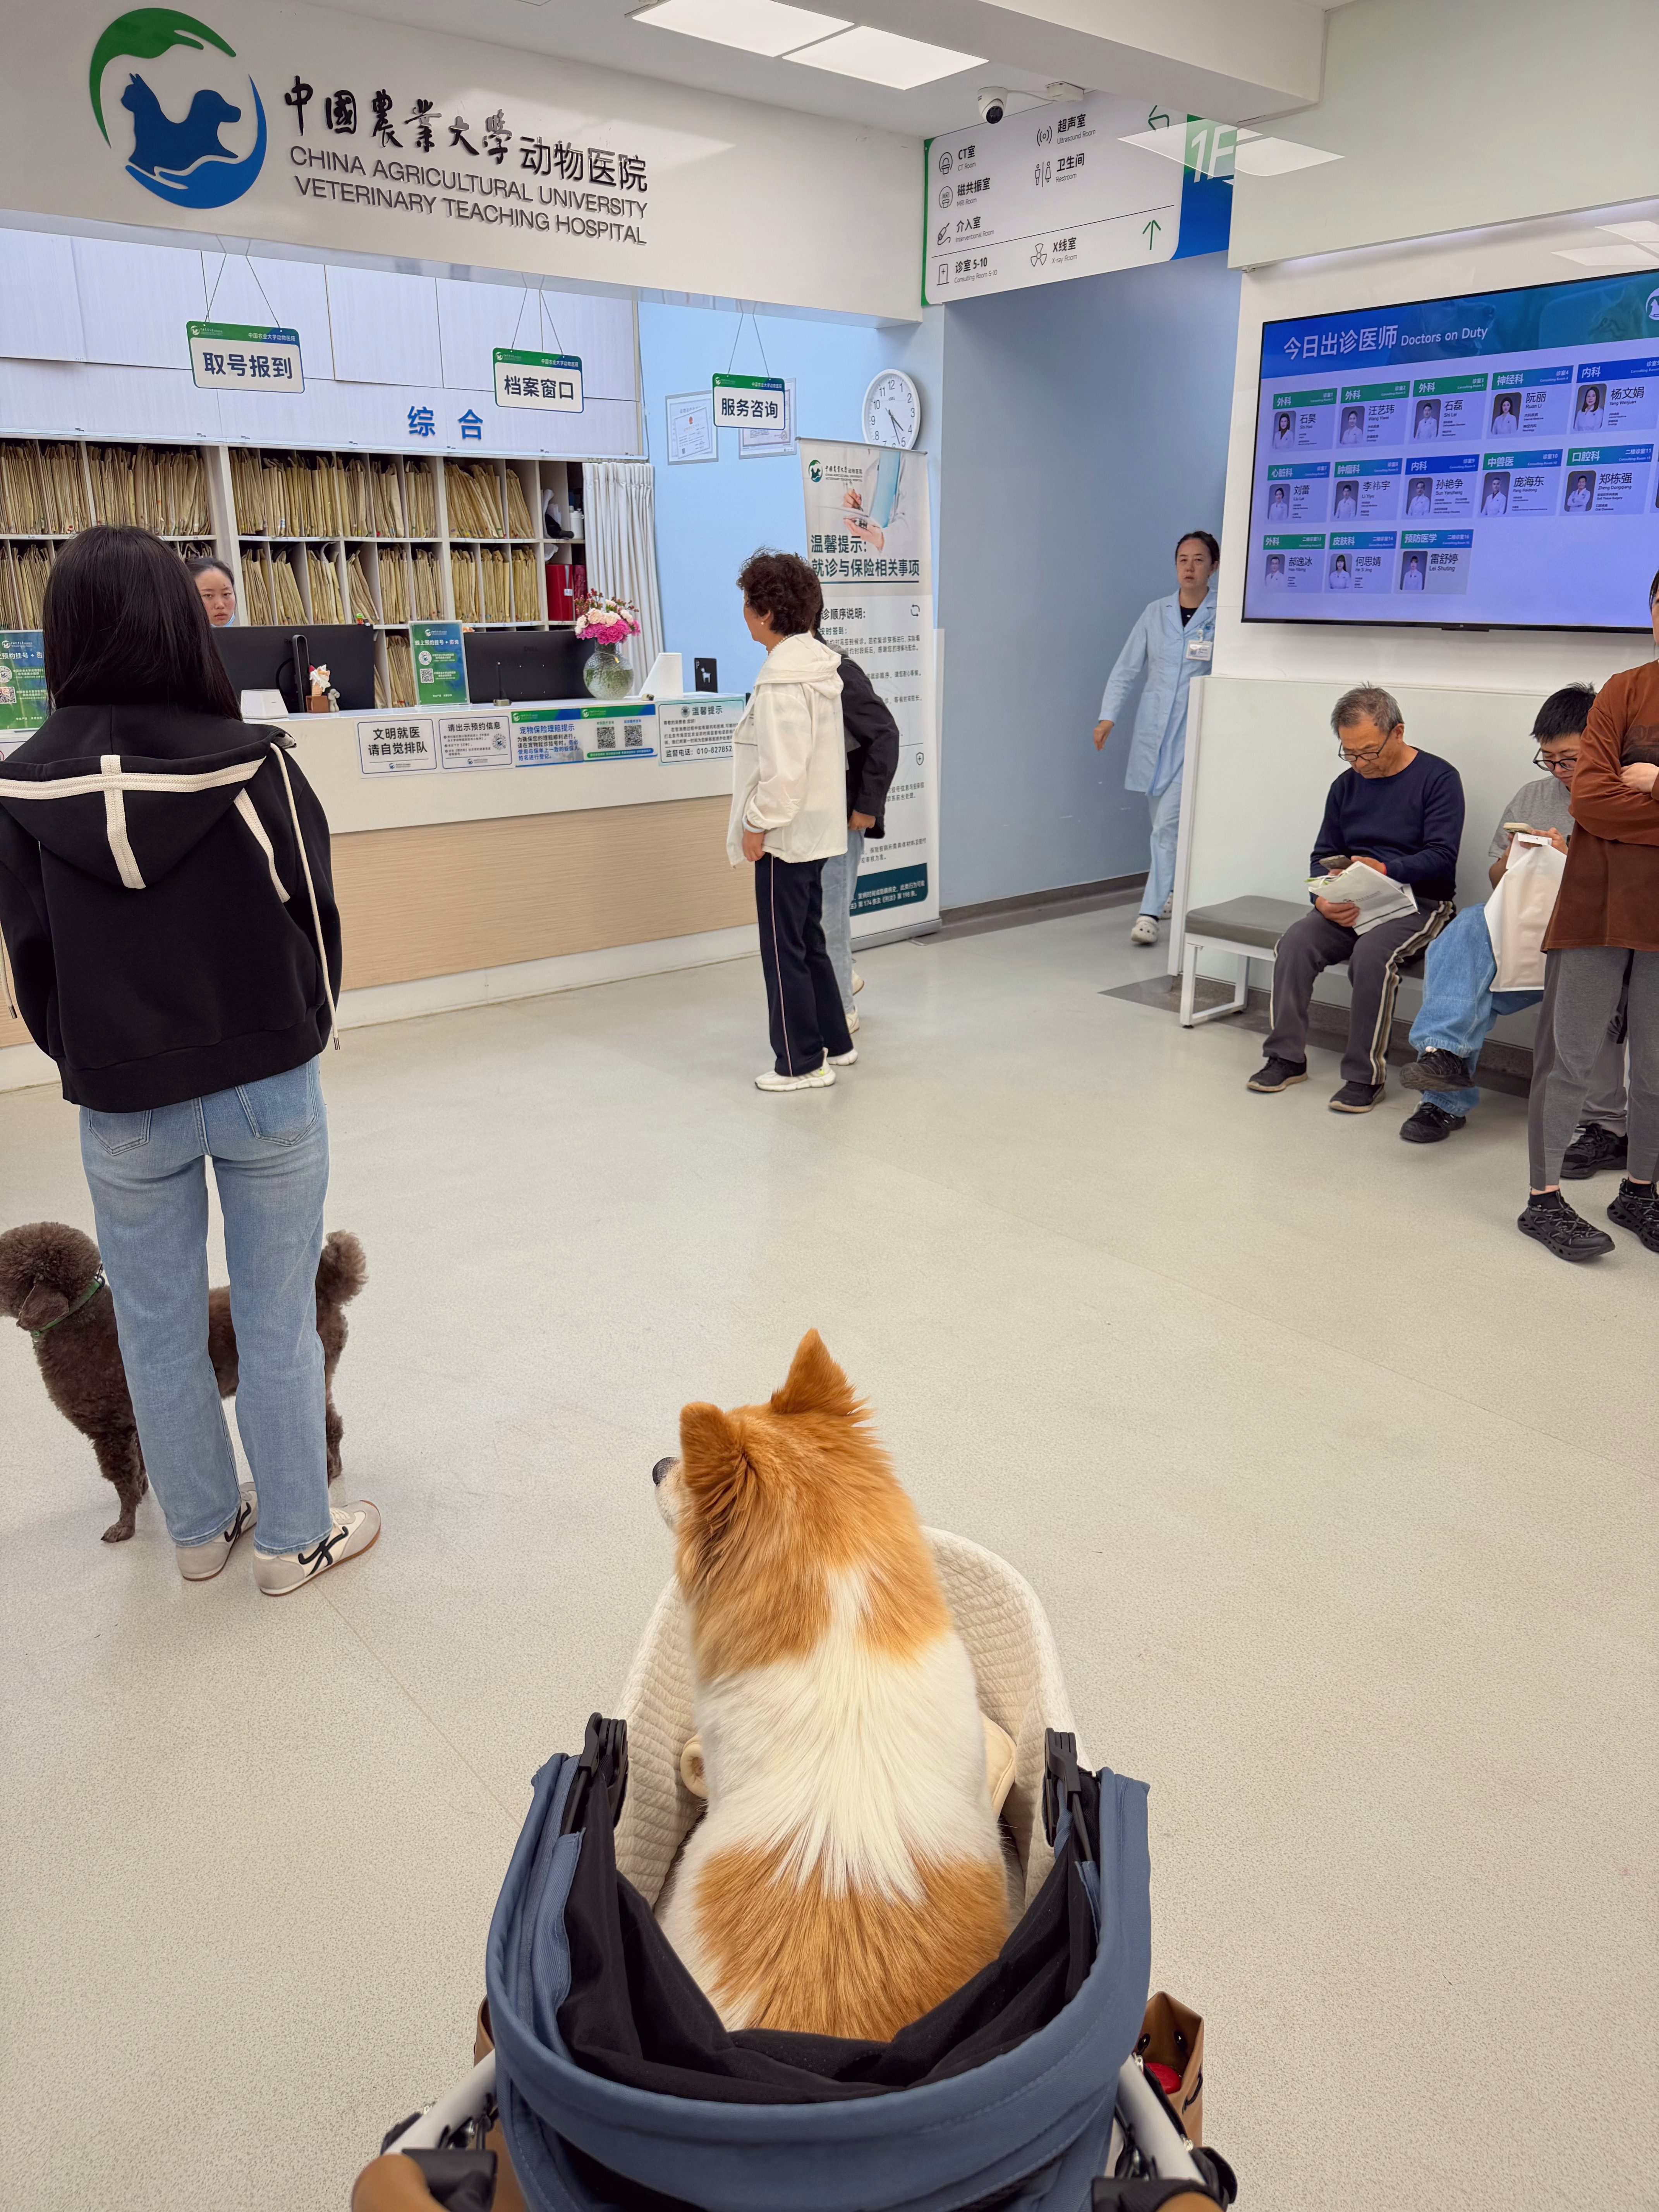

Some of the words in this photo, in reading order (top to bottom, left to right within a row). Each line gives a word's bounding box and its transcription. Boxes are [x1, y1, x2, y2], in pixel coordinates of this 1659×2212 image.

[1058, 113, 1085, 133] 超声室
[1057, 132, 1081, 144] Ultrasound
[958, 145, 975, 160] CT室
[1191, 124, 1238, 183] 1F
[1056, 153, 1084, 172] 卫生间
[290, 146, 366, 175] CHINA
[373, 160, 533, 202] AGRICULTURAL
[538, 186, 647, 219] UNIVERSITY
[1056, 173, 1077, 183] Restroom
[957, 177, 990, 196] 磁共振室
[294, 175, 437, 213] VETERINARY
[443, 198, 550, 232] TEACHING
[556, 214, 647, 245] HOSPITAL
[957, 216, 981, 233] 介入室
[955, 232, 982, 242] Interventional
[1053, 237, 1077, 252] X线室
[955, 259, 971, 273] 诊室
[973, 257, 987, 269] 5-10
[954, 275, 975, 283] Consulting
[1283, 325, 1398, 360] 今日出诊医师
[1401, 332, 1441, 346] Doctors
[1445, 332, 1458, 341] on
[1462, 327, 1488, 341] Duty
[203, 352, 292, 379] 取号报到
[1582, 366, 1601, 378] 内科
[888, 380, 895, 390] 12
[1497, 373, 1524, 386] 神经科
[504, 374, 574, 400] 档案窗口
[879, 386, 885, 397] 11
[900, 383, 903, 392] 1
[1419, 382, 1435, 393] 外科
[907, 393, 912, 403] 2
[1345, 390, 1360, 400] 外科
[1526, 392, 1547, 403] 阮丽
[1611, 386, 1644, 400] 杨文娟
[874, 400, 880, 410] 10
[1277, 396, 1291, 406] 外科
[1444, 400, 1463, 411] 石磊
[721, 398, 778, 419] 服务咨询
[910, 407, 915, 417] 3
[1369, 404, 1395, 416] 汪艺玮
[871, 416, 875, 425] 9
[1300, 414, 1316, 424] 石昊
[908, 424, 912, 433] 4
[875, 431, 879, 440] 8
[901, 437, 906, 447] 5
[1572, 450, 1600, 462] 口腔科
[1411, 461, 1427, 471] 内科
[1487, 457, 1514, 467] 中兽医
[1271, 467, 1293, 477] 心脏科
[1337, 464, 1360, 474] 肿瘤科
[1514, 476, 1545, 487] 庞海东
[1599, 472, 1632, 484] 郑栋强
[1436, 479, 1463, 489] 孙艳争
[1293, 485, 1310, 495] 刘蕾
[1266, 537, 1279, 546] 外科
[1333, 536, 1355, 546] 皮肤科
[1405, 534, 1437, 543] 预防医学
[1288, 557, 1312, 567] 郝逸冰
[1431, 553, 1458, 564] 雷舒婷
[811, 558, 920, 577] 就诊与保险相关事项
[692, 706, 722, 716] 温馨提示
[448, 721, 501, 732] 请出示预约信息
[520, 724, 575, 734] 宠物保险理赔提示
[373, 726, 420, 740] 文明就医
[368, 741, 428, 756] 请自觉排队
[697, 746, 732, 754] 010-827852
